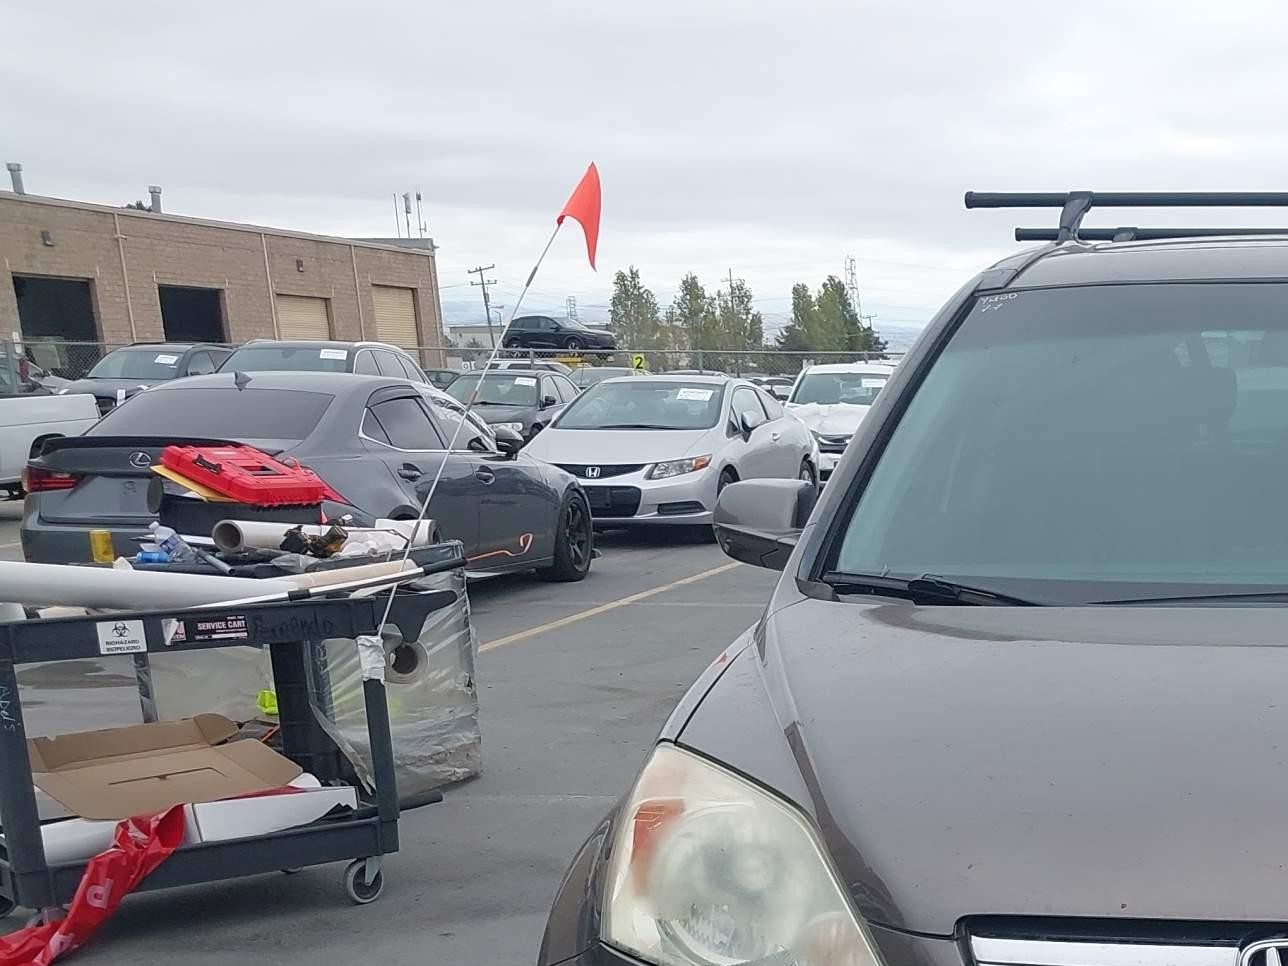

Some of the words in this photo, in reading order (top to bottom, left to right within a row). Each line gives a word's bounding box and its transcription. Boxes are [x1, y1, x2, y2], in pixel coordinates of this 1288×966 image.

[635, 357, 643, 369] 2
[197, 621, 227, 631] SERVICE
[227, 620, 246, 629] CART
